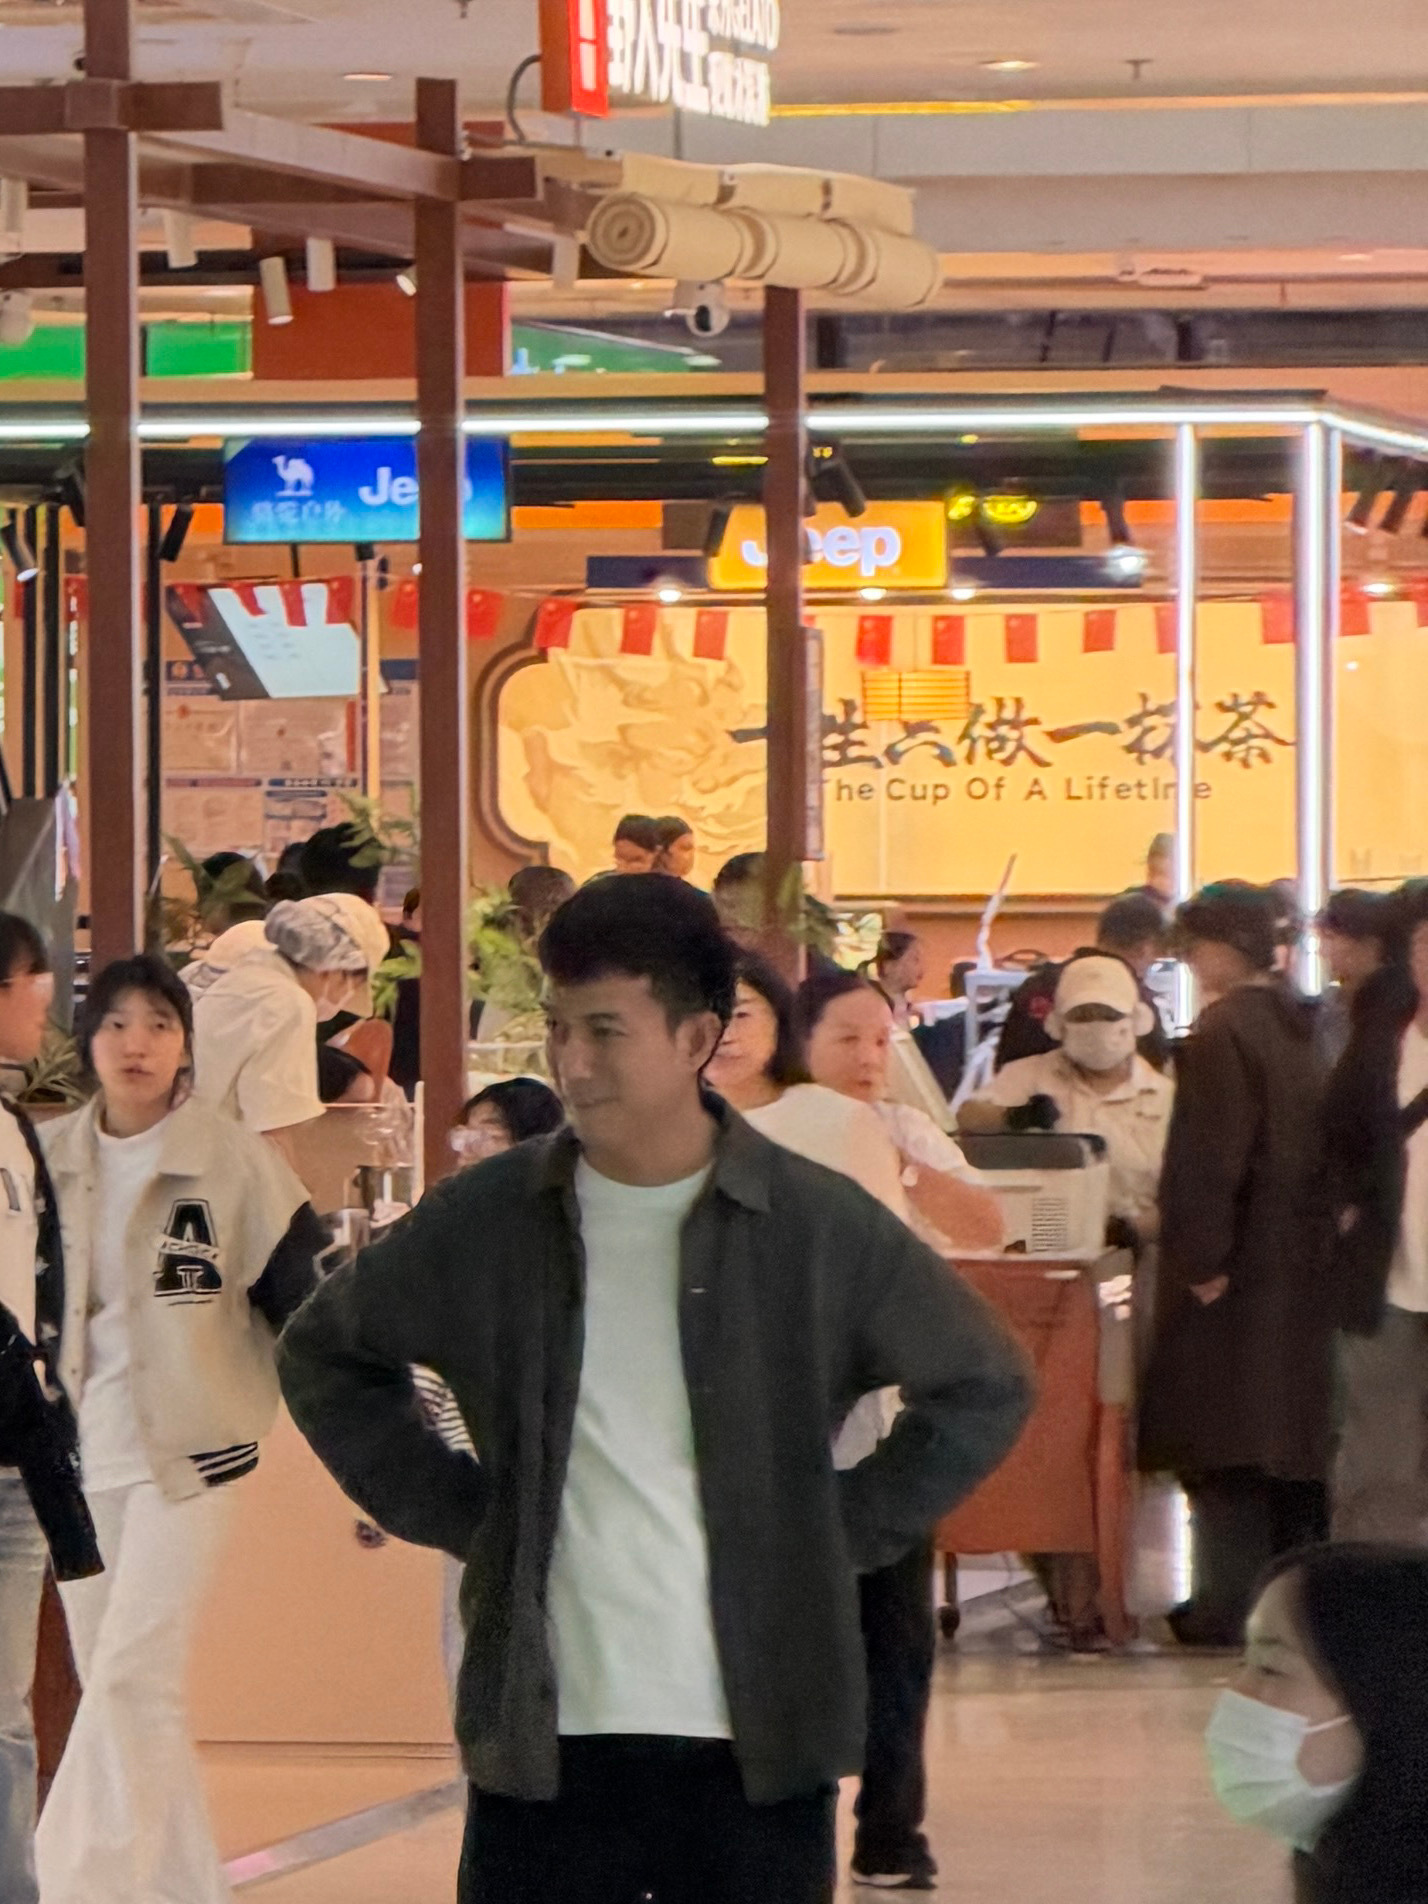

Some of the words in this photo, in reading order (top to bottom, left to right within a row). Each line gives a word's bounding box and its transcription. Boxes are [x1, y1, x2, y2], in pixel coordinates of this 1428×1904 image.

[822, 778, 875, 800] he
[885, 777, 951, 806] Cup
[966, 776, 1006, 800] Of
[1024, 778, 1048, 800] A
